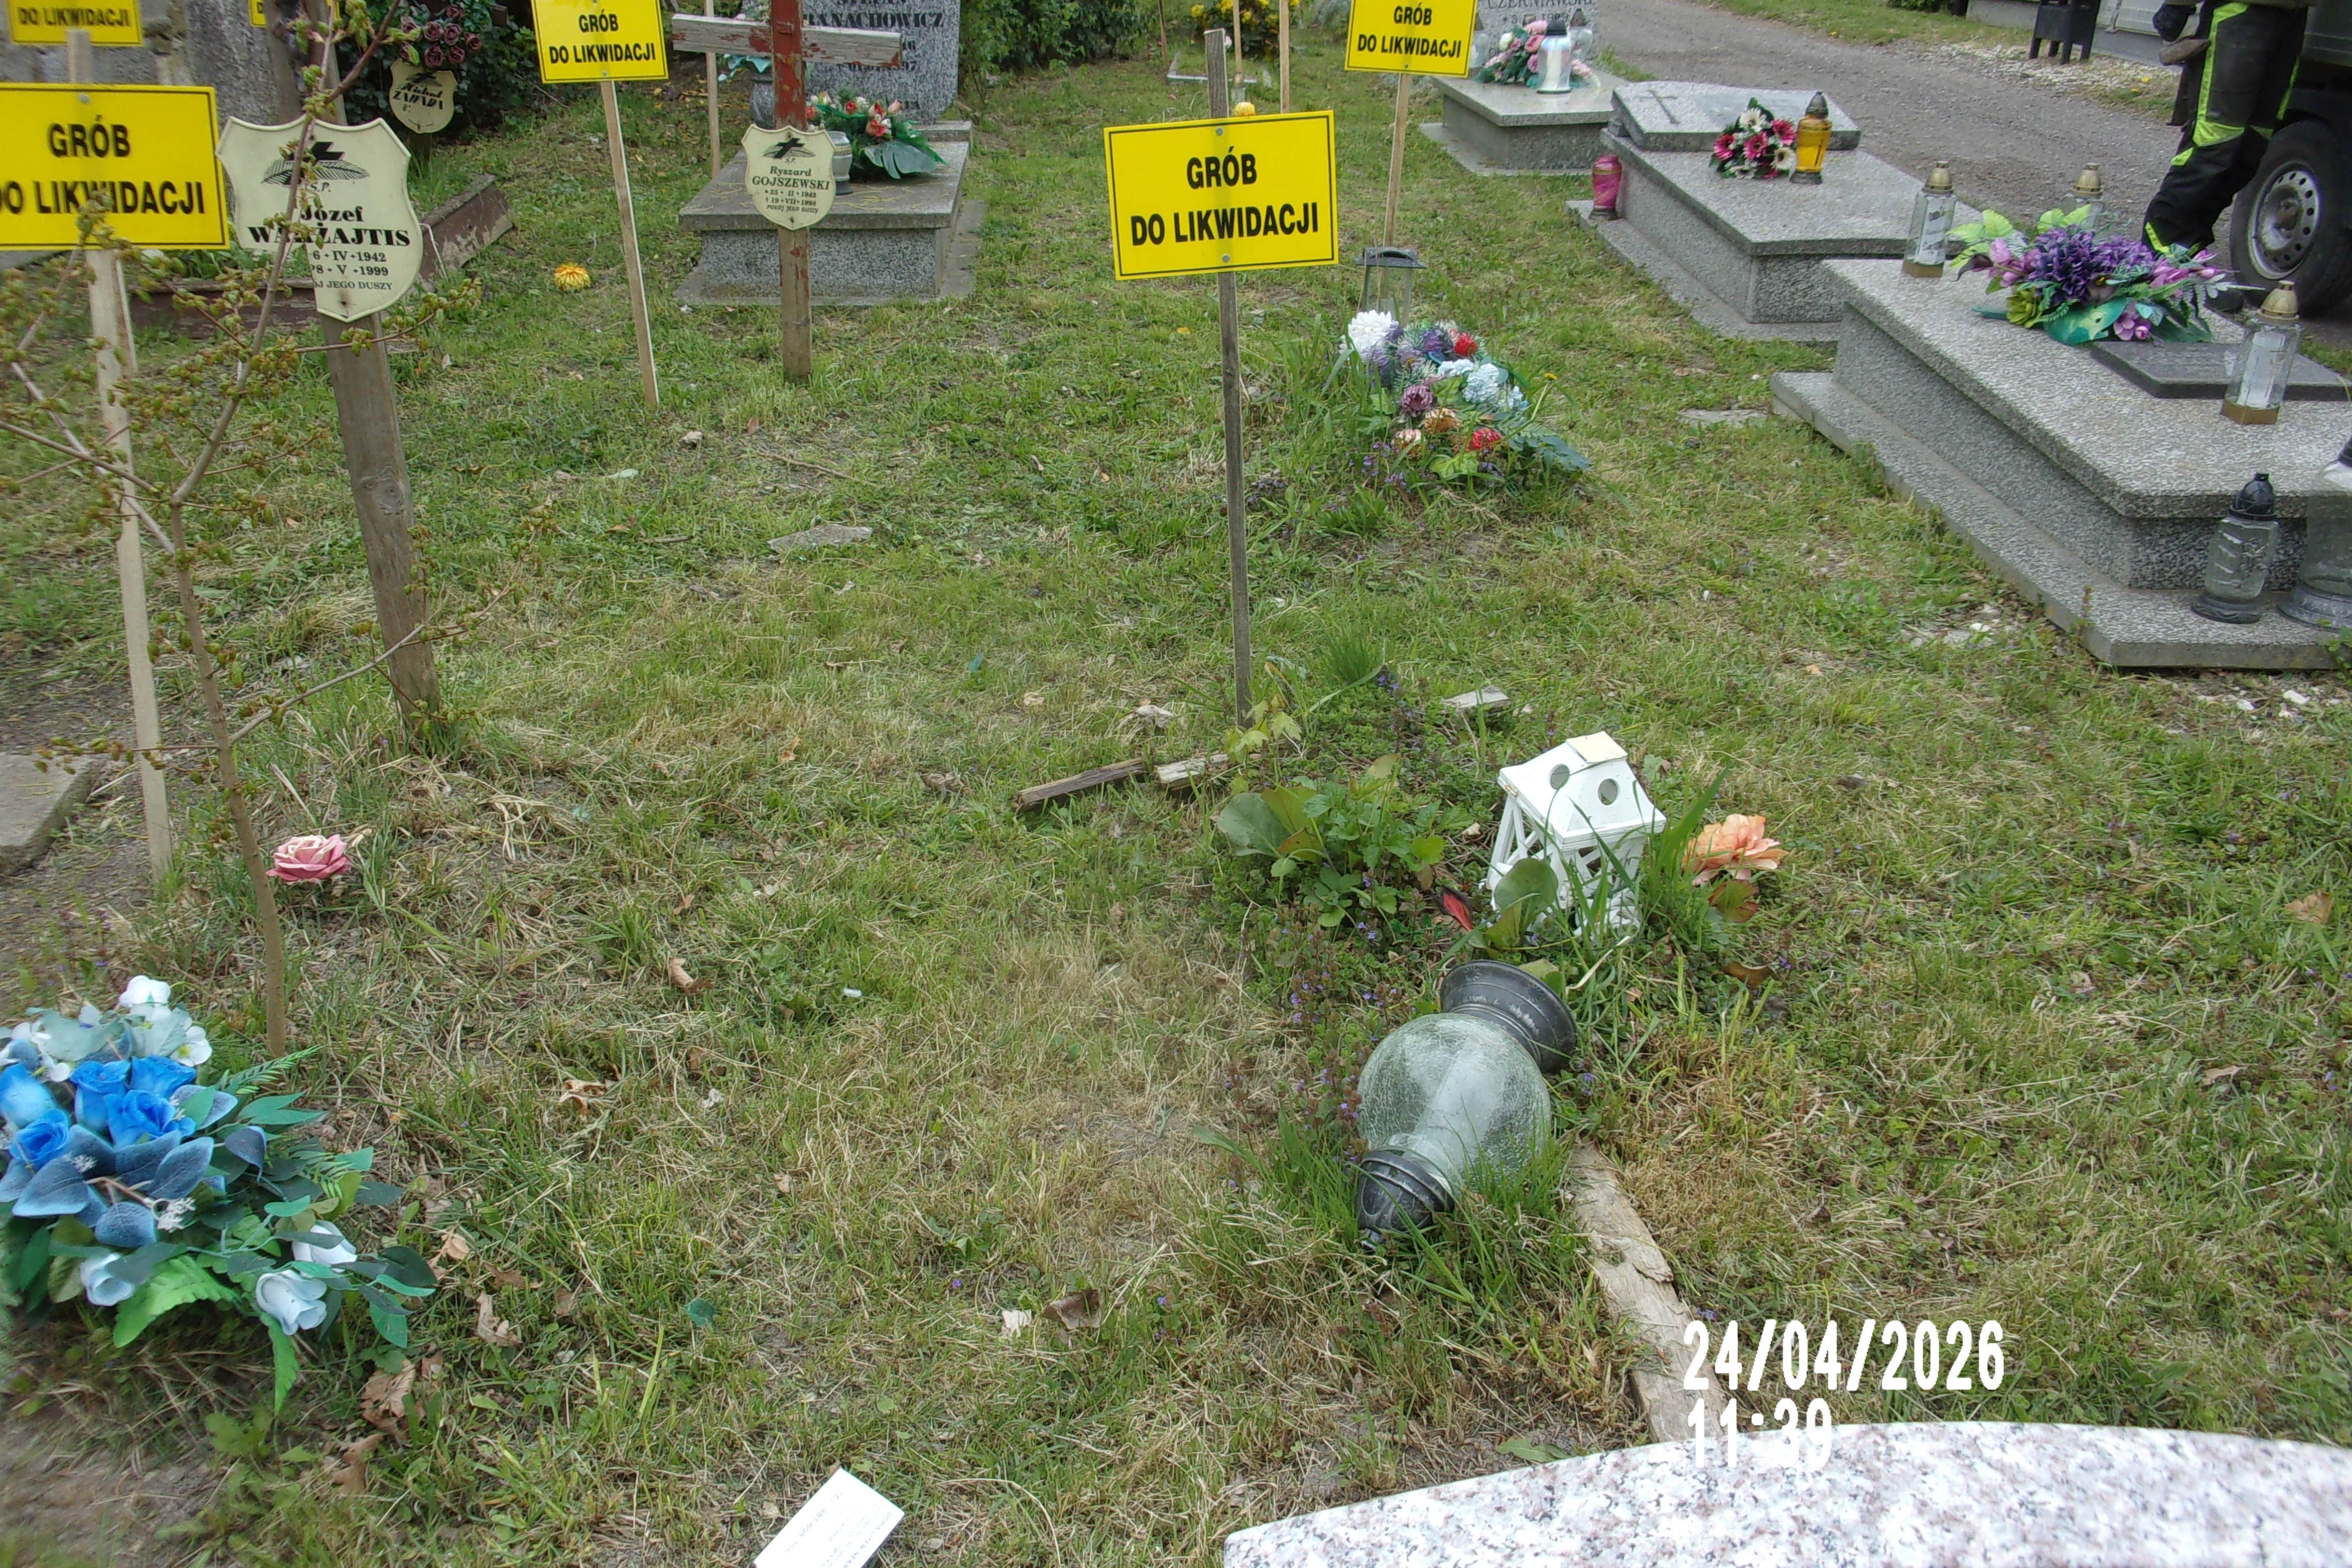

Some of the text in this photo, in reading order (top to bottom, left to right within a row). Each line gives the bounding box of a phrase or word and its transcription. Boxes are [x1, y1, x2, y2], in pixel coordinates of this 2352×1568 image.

[18, 7, 130, 27] DO LIKWIDACJI
[579, 9, 619, 33] GRÓB
[1393, 2, 1432, 26] GRÓB
[549, 42, 656, 64] DO LIKWIDACJI
[1357, 34, 1462, 58] DO LIKWIDACJI
[47, 114, 131, 157] GRÓB
[770, 166, 812, 177] Ryszard
[1186, 146, 1257, 189] GRÓB
[752, 176, 830, 190] GOJSZEWSKI
[0, 181, 23, 214] O
[1131, 202, 1318, 246] DO LIKWIDACJI
[332, 251, 348, 261] IV
[356, 252, 386, 262] 1942
[336, 264, 347, 275] V
[359, 266, 388, 276] 1999
[327, 281, 355, 289] JEGO
[358, 282, 393, 290] DUSZY
